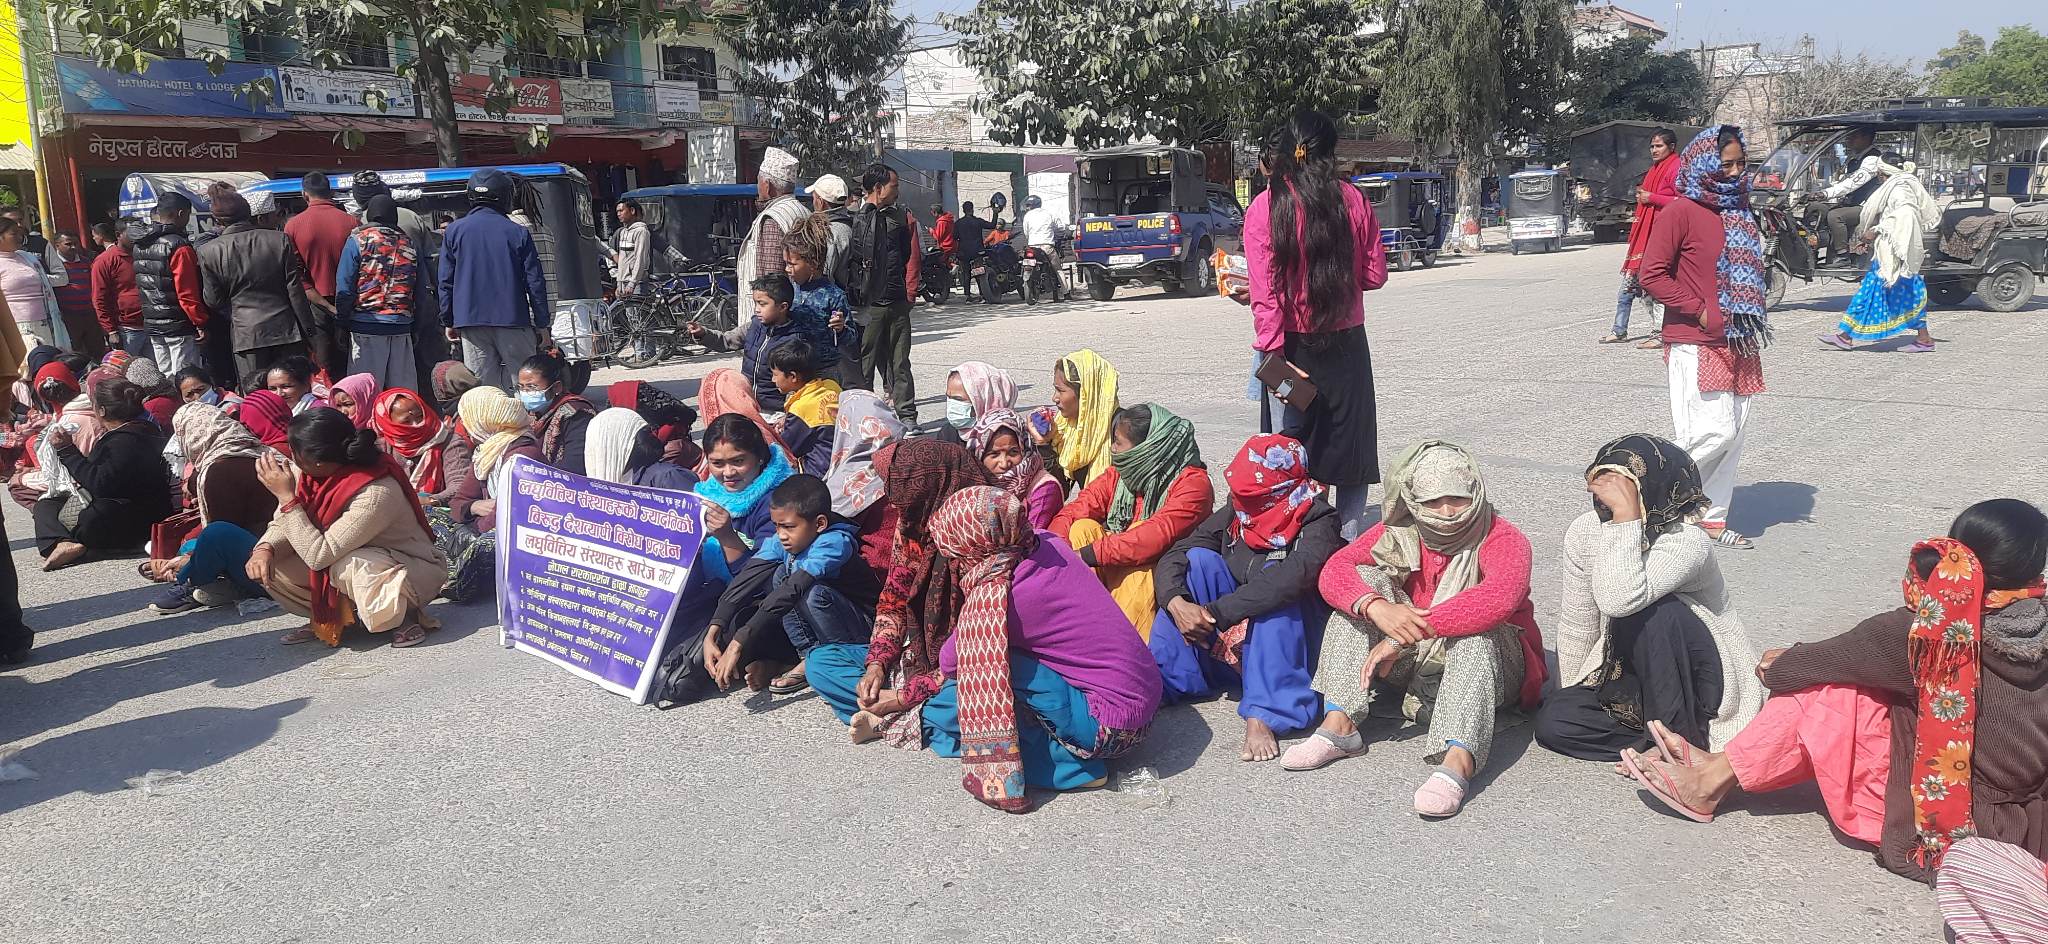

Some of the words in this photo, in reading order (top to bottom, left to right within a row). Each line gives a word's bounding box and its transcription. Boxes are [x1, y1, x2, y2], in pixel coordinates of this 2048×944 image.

[117, 78, 162, 89] NATURAL
[164, 81, 193, 91] HOTEL
[196, 83, 203, 91] &
[206, 83, 235, 92] LODGE
[88, 133, 143, 161] नेचुरल
[145, 136, 188, 159] होटल
[209, 141, 239, 159] लज
[1085, 221, 1114, 233] NEPAL
[1137, 218, 1165, 229] POLICE
[645, 537, 682, 559] प्रदर्शन
[627, 559, 656, 581] खारेज
